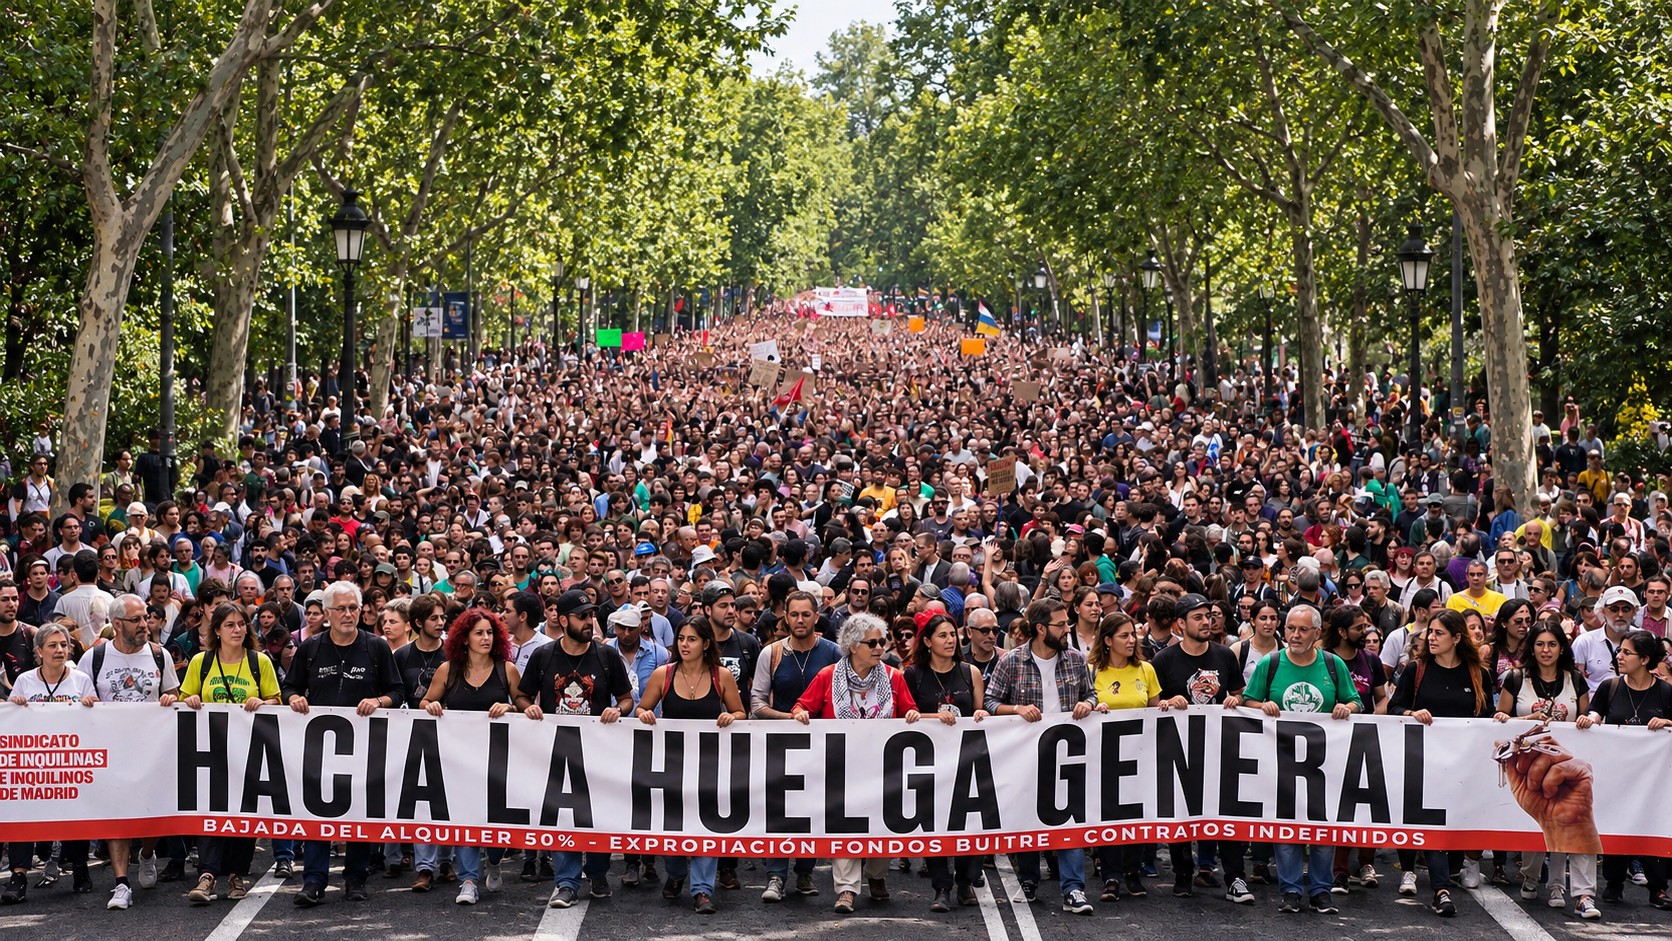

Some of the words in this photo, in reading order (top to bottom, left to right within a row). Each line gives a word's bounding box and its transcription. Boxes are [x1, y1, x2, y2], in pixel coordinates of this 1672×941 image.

[0, 734, 80, 748] SINDICATO
[0, 753, 17, 767] DE
[20, 752, 104, 769] INQUILINAS
[10, 770, 94, 786] INQUILINOS
[177, 710, 451, 822] HACIA
[487, 722, 594, 829] LA
[631, 728, 1002, 834] HUELGA
[1036, 714, 1447, 827] GENERAL
[0, 787, 18, 800] DE
[21, 786, 79, 800] MADRID
[203, 818, 307, 837] BAJADA
[320, 823, 369, 839] DEL
[380, 825, 511, 845] ALQUILER
[524, 831, 576, 848] 50%
[609, 835, 816, 855] EXPROPIACIÓN
[830, 839, 943, 855] FONDOS
[956, 833, 1050, 853] BUITRE
[1083, 822, 1236, 844] CONTRATOS
[1249, 824, 1425, 846] INDEFINIDOS
